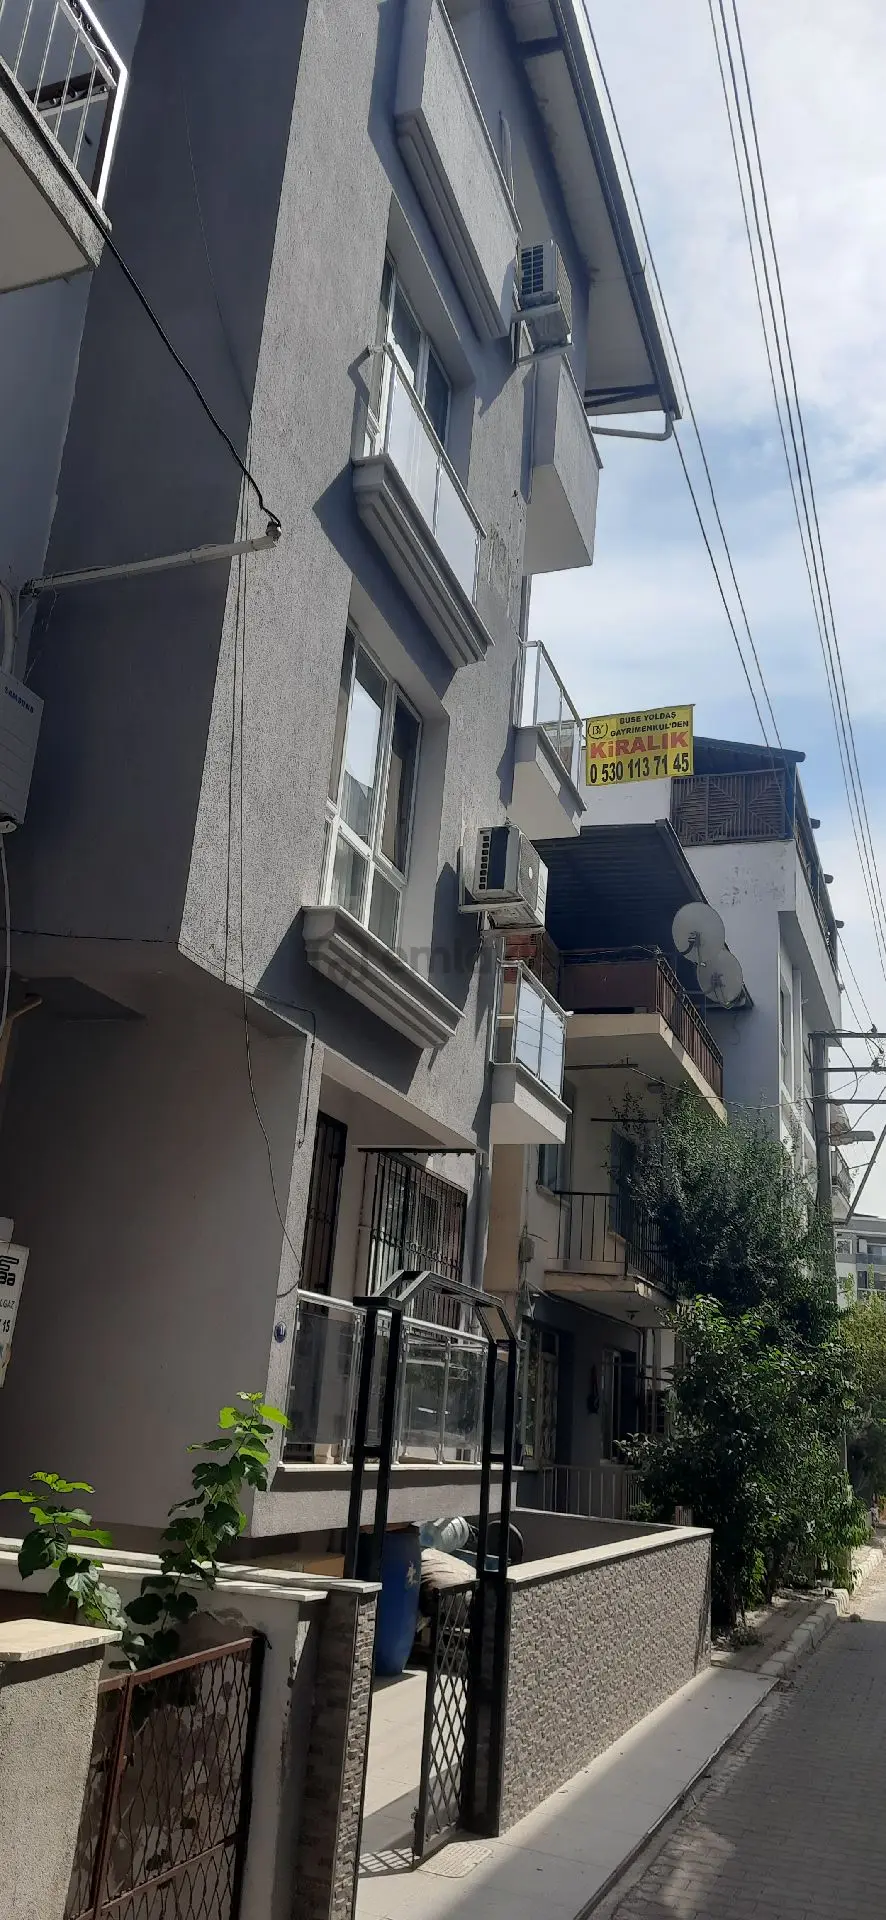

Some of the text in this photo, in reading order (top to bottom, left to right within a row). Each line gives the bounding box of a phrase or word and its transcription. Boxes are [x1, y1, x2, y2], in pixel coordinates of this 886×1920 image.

[620, 715, 641, 725] BUSE
[590, 752, 689, 783] 0 530 113 71 45
[3, 1319, 11, 1332] 15
